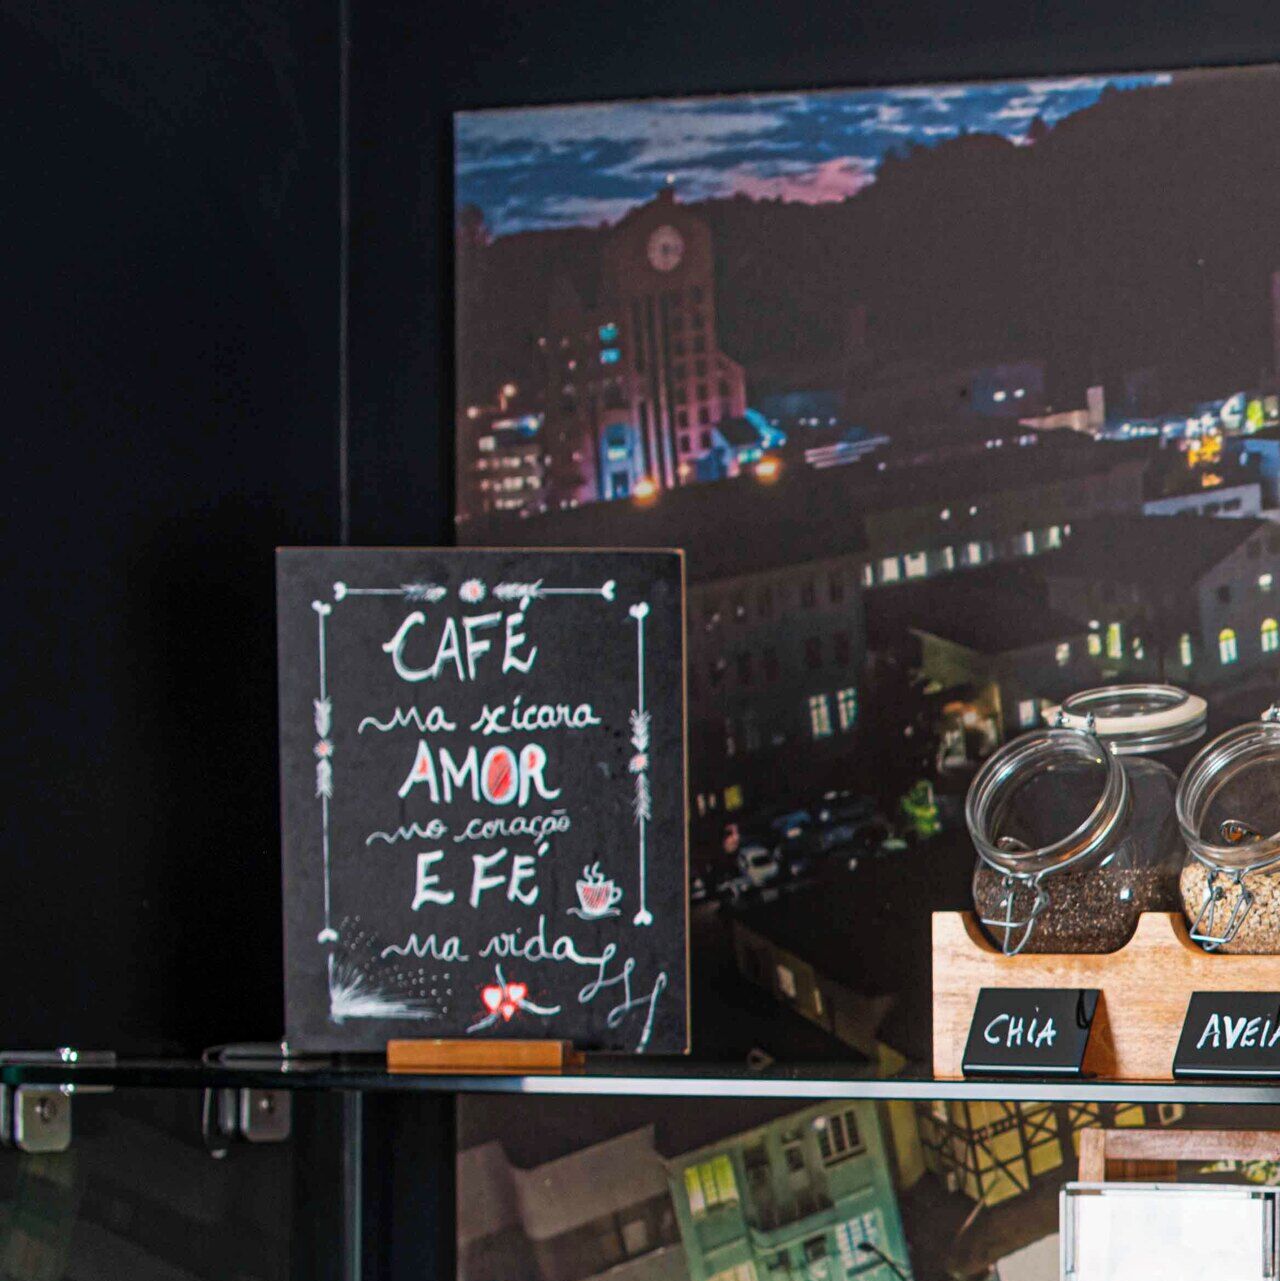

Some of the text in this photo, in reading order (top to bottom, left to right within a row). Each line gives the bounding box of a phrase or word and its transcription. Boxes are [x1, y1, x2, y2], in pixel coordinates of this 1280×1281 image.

[383, 597, 537, 682] CAFÉ
[470, 696, 601, 735] xícara
[398, 740, 560, 805] AMOR
[454, 809, 570, 842] coração
[412, 842, 549, 911] E FÉ
[983, 1006, 1057, 1048] CHIA
